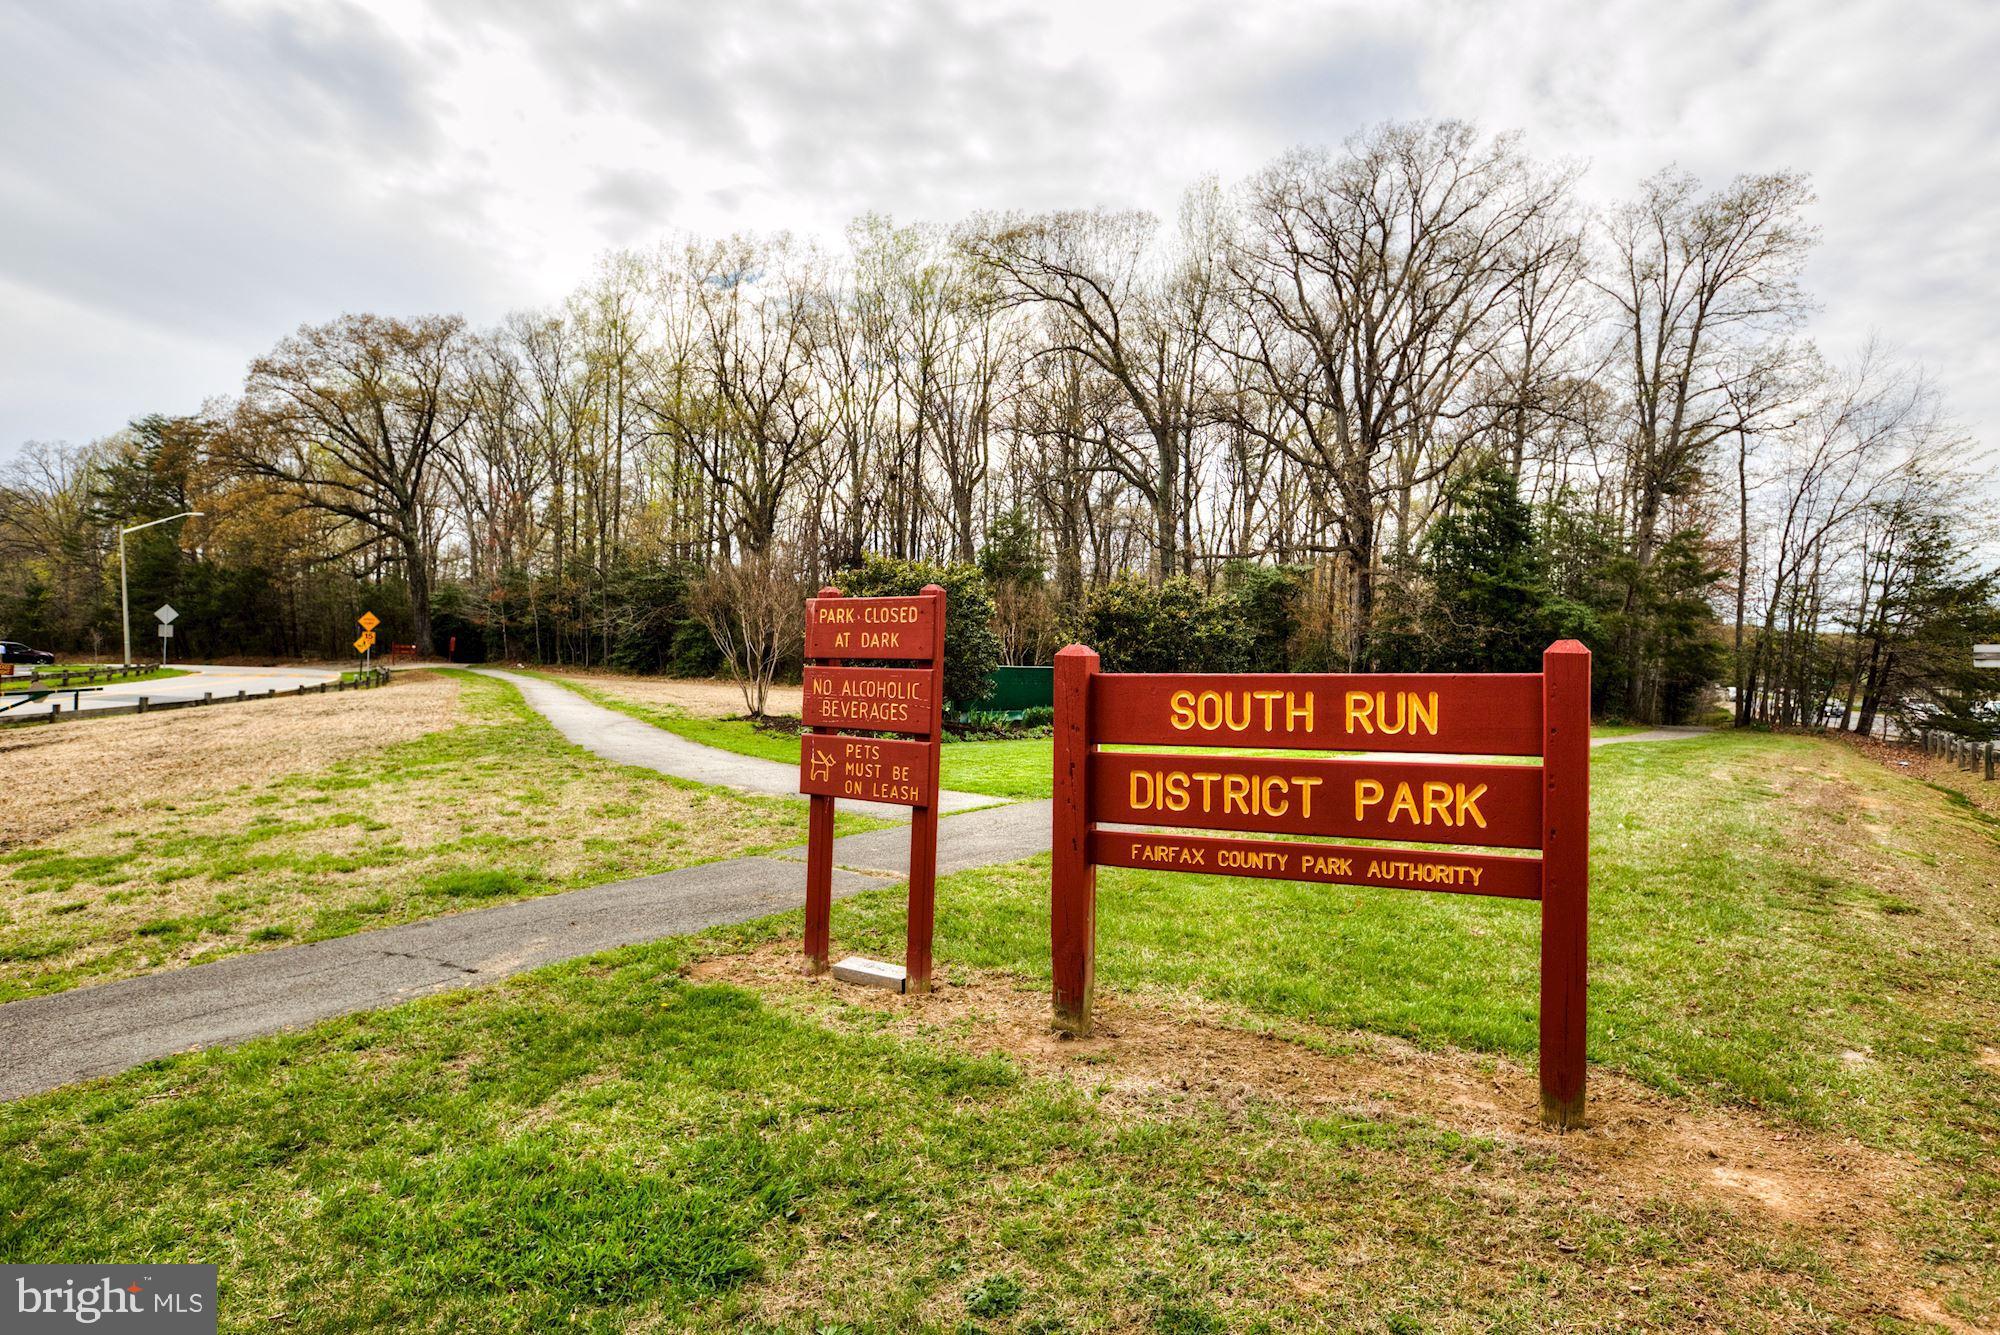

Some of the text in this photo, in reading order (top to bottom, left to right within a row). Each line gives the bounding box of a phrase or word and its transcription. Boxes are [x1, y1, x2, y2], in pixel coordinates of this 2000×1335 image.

[819, 606, 919, 624] PARK CLOSED
[834, 632, 900, 648] AT DARK
[813, 678, 920, 700] NO ALCOHOLIC
[822, 700, 909, 721] BEVERAGES
[1170, 689, 1439, 735] SOUTH RUN
[845, 744, 880, 760] PETS
[845, 762, 909, 782] MUST BE
[844, 780, 919, 802] ON LEASH
[1129, 769, 1489, 829] DISTRICT PARK
[1130, 843, 1484, 887] FAIRFAX COUNTY PARK AUTHORITY
